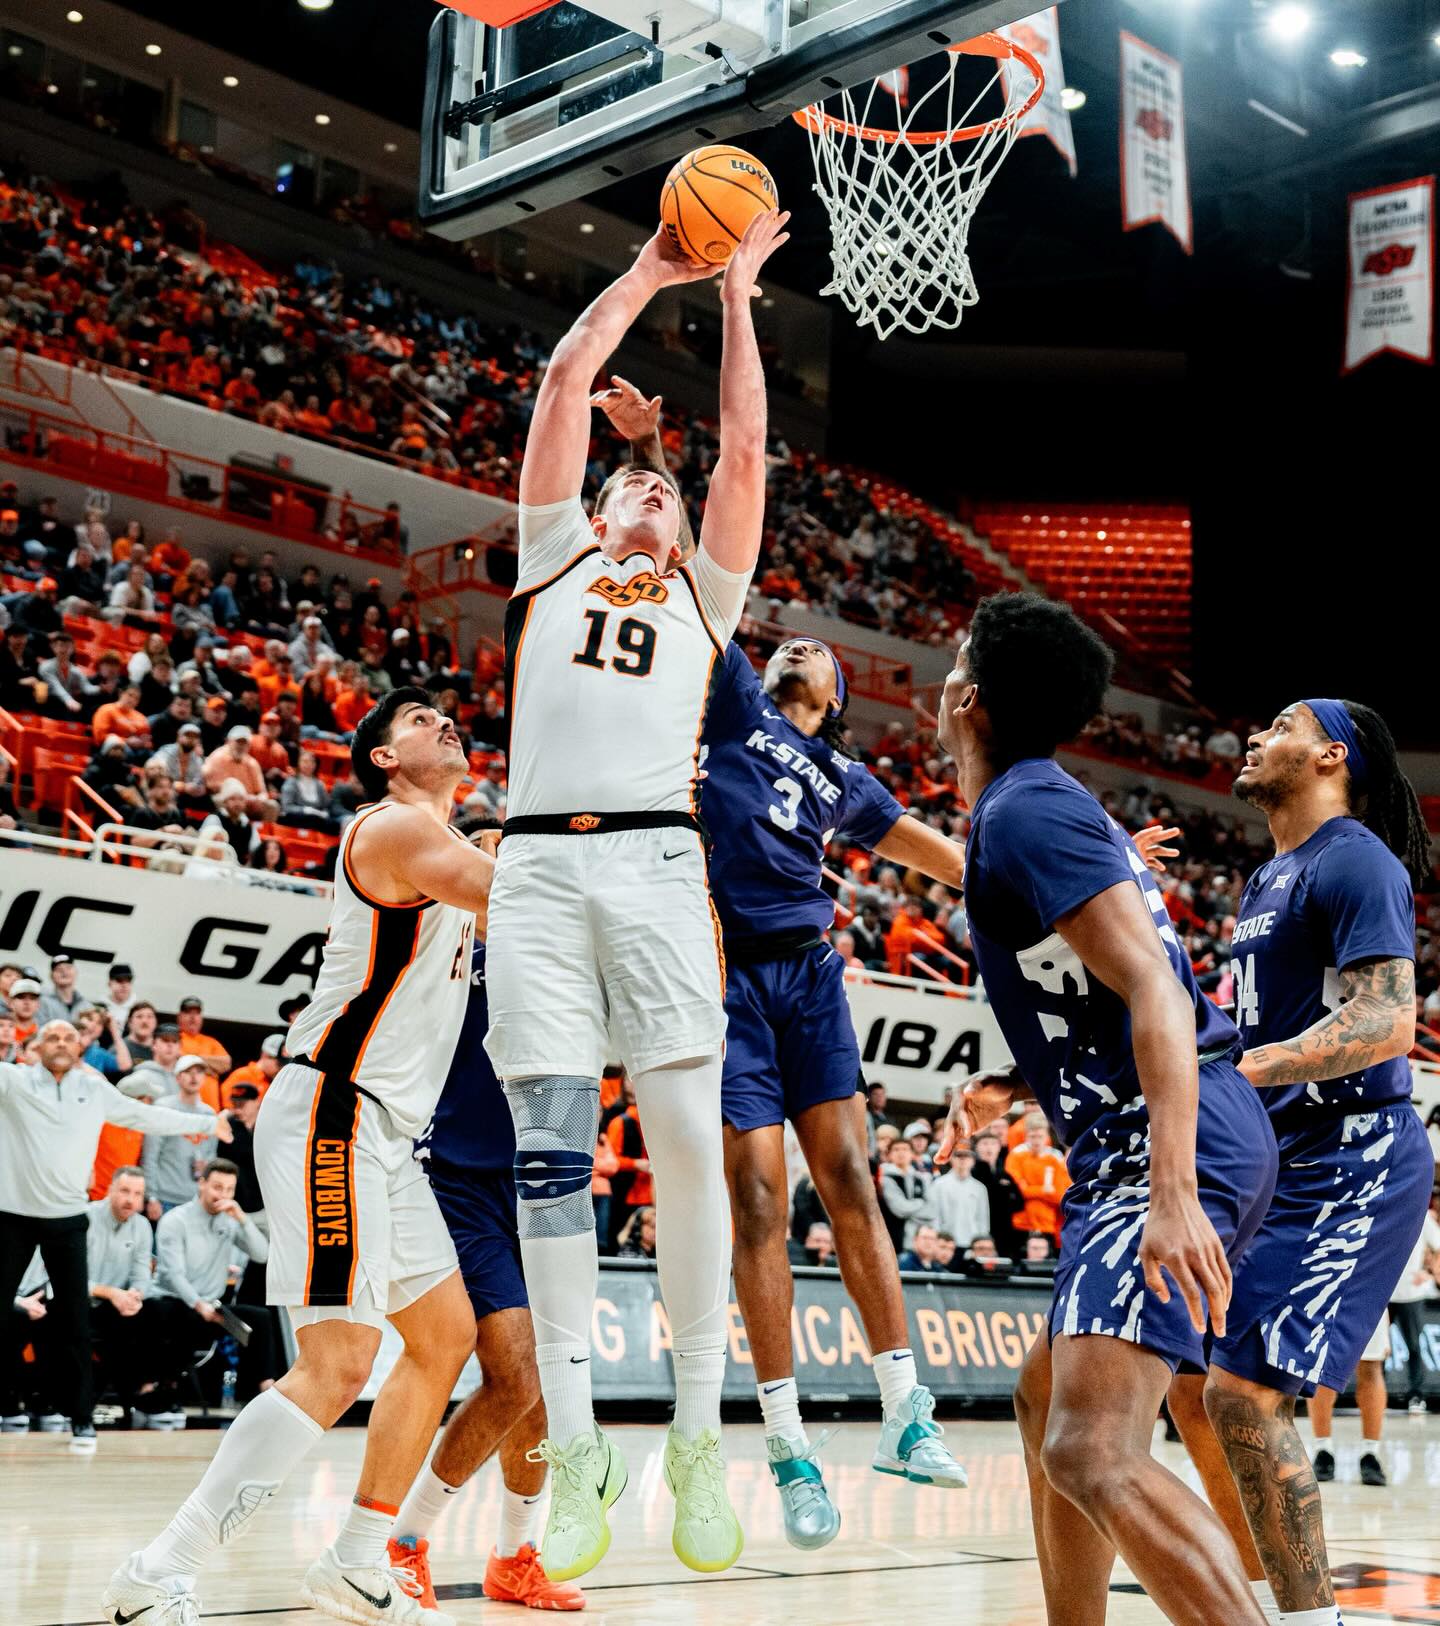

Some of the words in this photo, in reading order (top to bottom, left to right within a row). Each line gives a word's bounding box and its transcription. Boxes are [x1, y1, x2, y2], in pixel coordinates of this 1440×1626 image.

[571, 608, 657, 678] 19
[745, 729, 842, 804] K-STATE
[569, 814, 601, 831] OSU
[768, 776, 803, 832] 3
[861, 1017, 981, 1075] IBA
[315, 1138, 348, 1246] COWBOYS
